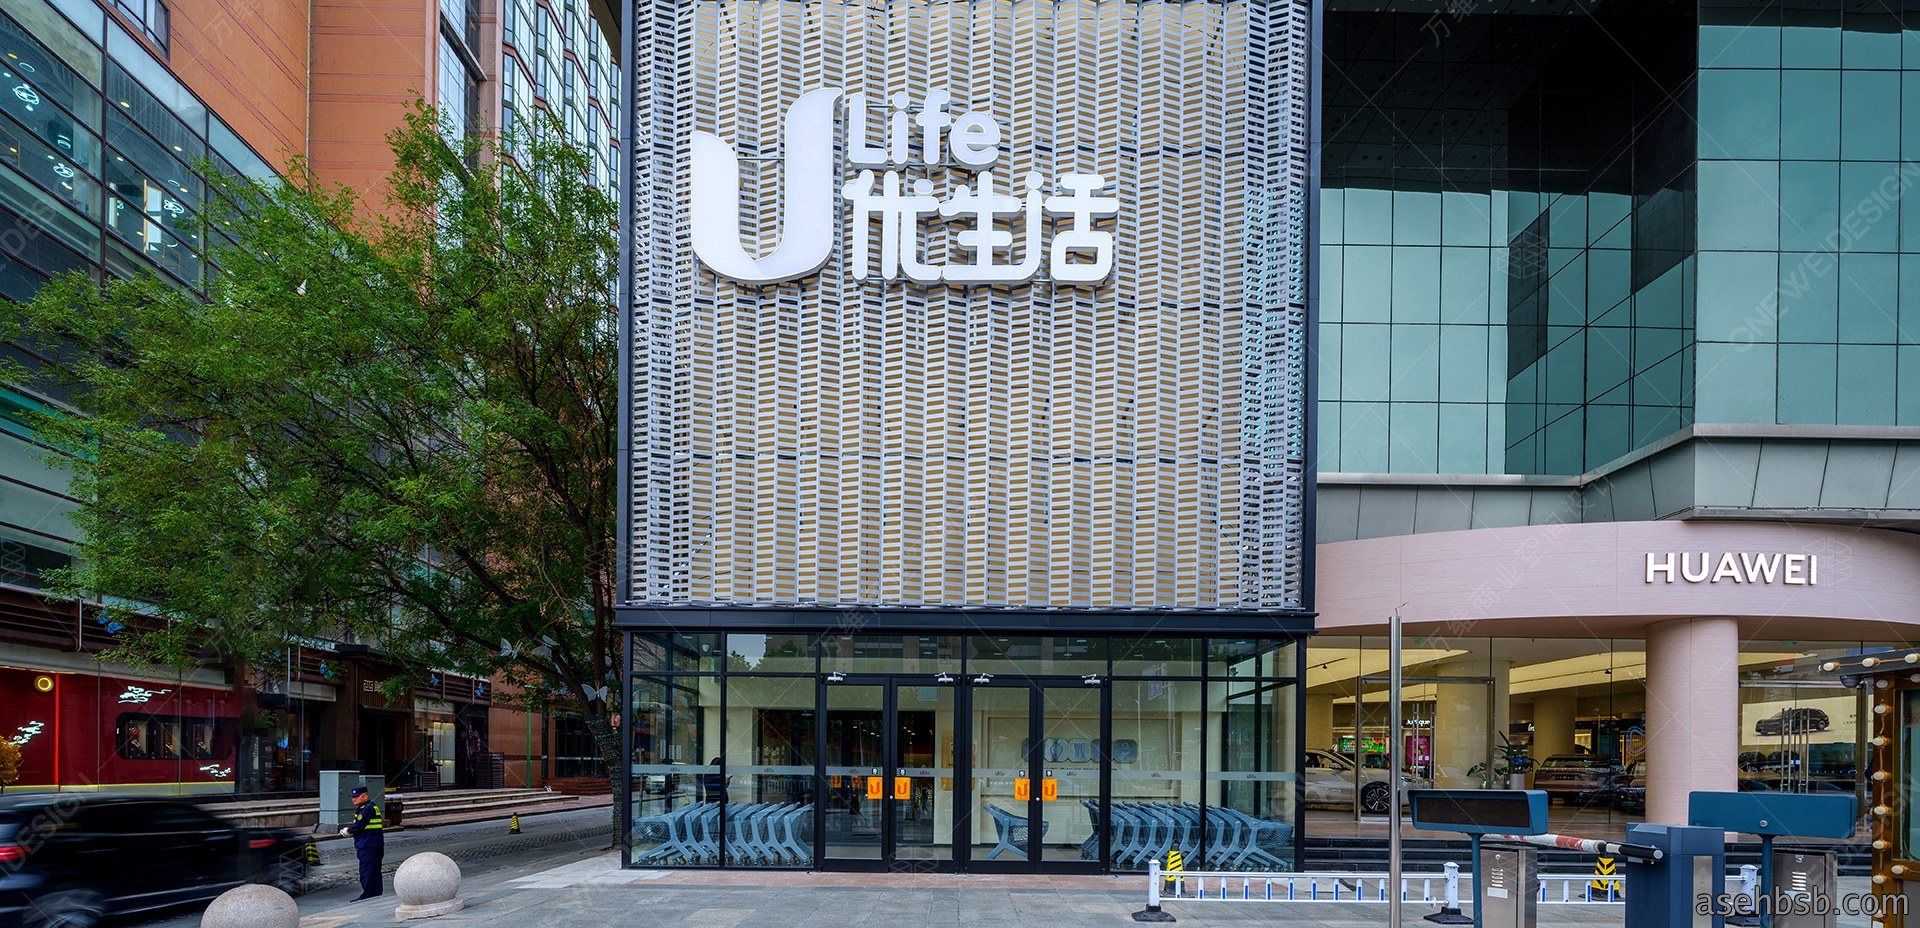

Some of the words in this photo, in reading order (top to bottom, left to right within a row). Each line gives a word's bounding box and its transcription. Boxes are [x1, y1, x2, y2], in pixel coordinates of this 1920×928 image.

[691, 86, 843, 283] U
[847, 88, 1001, 170] Life
[841, 170, 1120, 285] 优生活
[1645, 551, 1819, 586] HUAWEI
